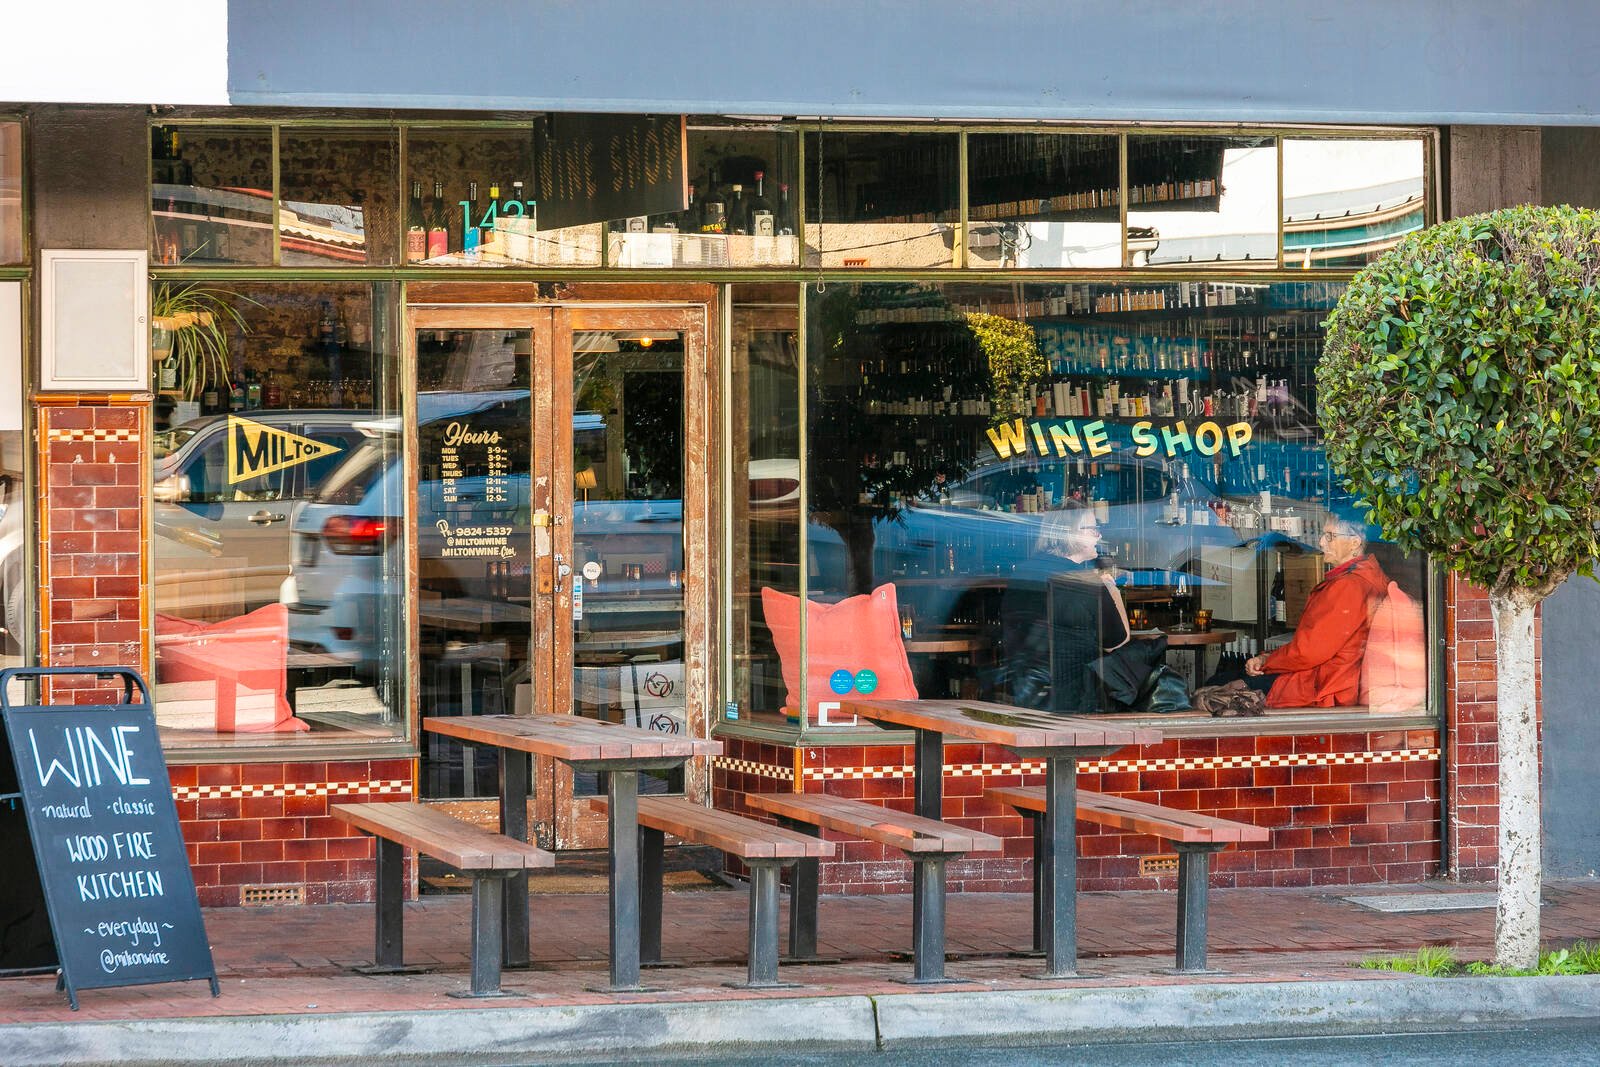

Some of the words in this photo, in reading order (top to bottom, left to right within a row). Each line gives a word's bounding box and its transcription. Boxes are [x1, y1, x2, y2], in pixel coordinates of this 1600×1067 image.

[540, 136, 597, 200] WINE
[610, 118, 678, 192] SHOP
[235, 422, 321, 476] MILTON
[443, 421, 503, 447] Hours
[985, 417, 1113, 459] WINE
[1131, 419, 1253, 459] SHOP
[28, 726, 151, 788] WINE
[42, 797, 93, 818] natural
[66, 835, 109, 864] WOOD
[112, 831, 157, 860] FIRE
[76, 870, 164, 902] KITCHEN
